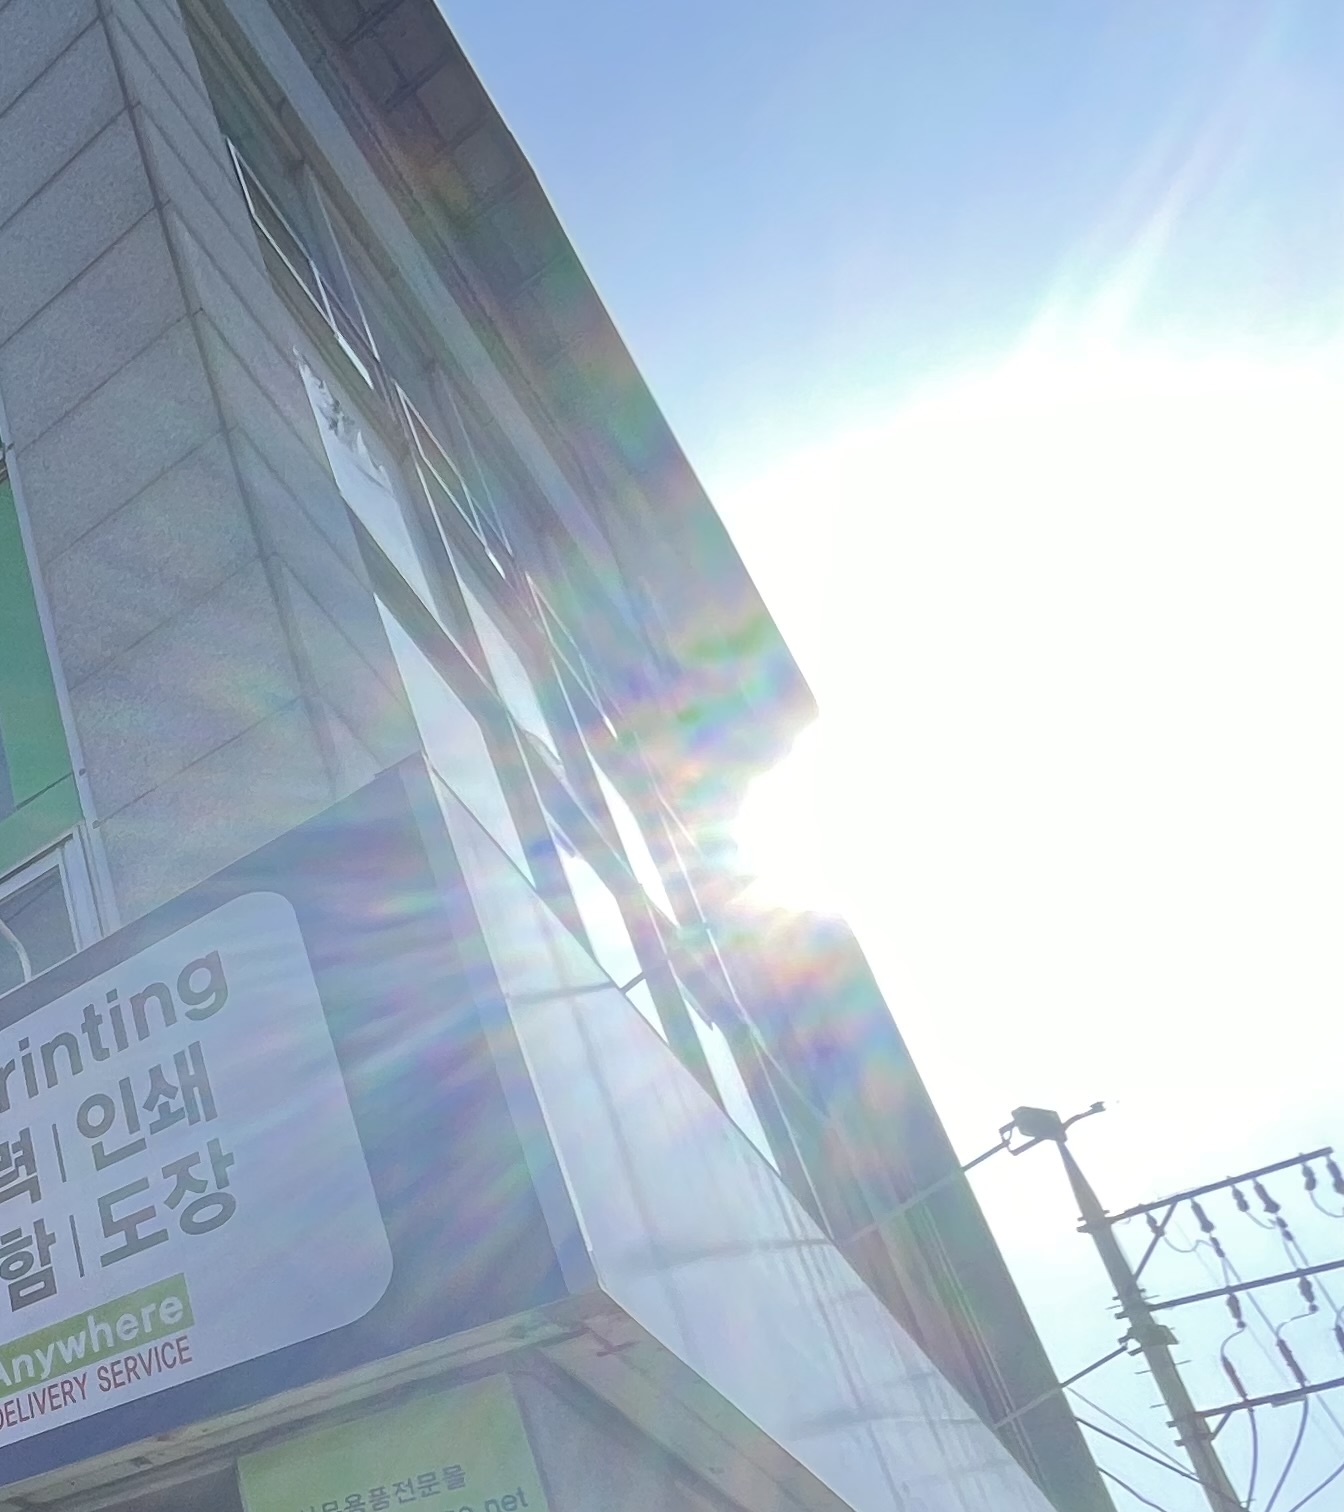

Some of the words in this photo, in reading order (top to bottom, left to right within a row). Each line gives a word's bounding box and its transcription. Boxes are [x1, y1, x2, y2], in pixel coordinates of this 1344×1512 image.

[75, 1039, 221, 1172] 인쇄
[97, 1138, 239, 1268] 도장
[97, 1334, 194, 1395] SERVICE
